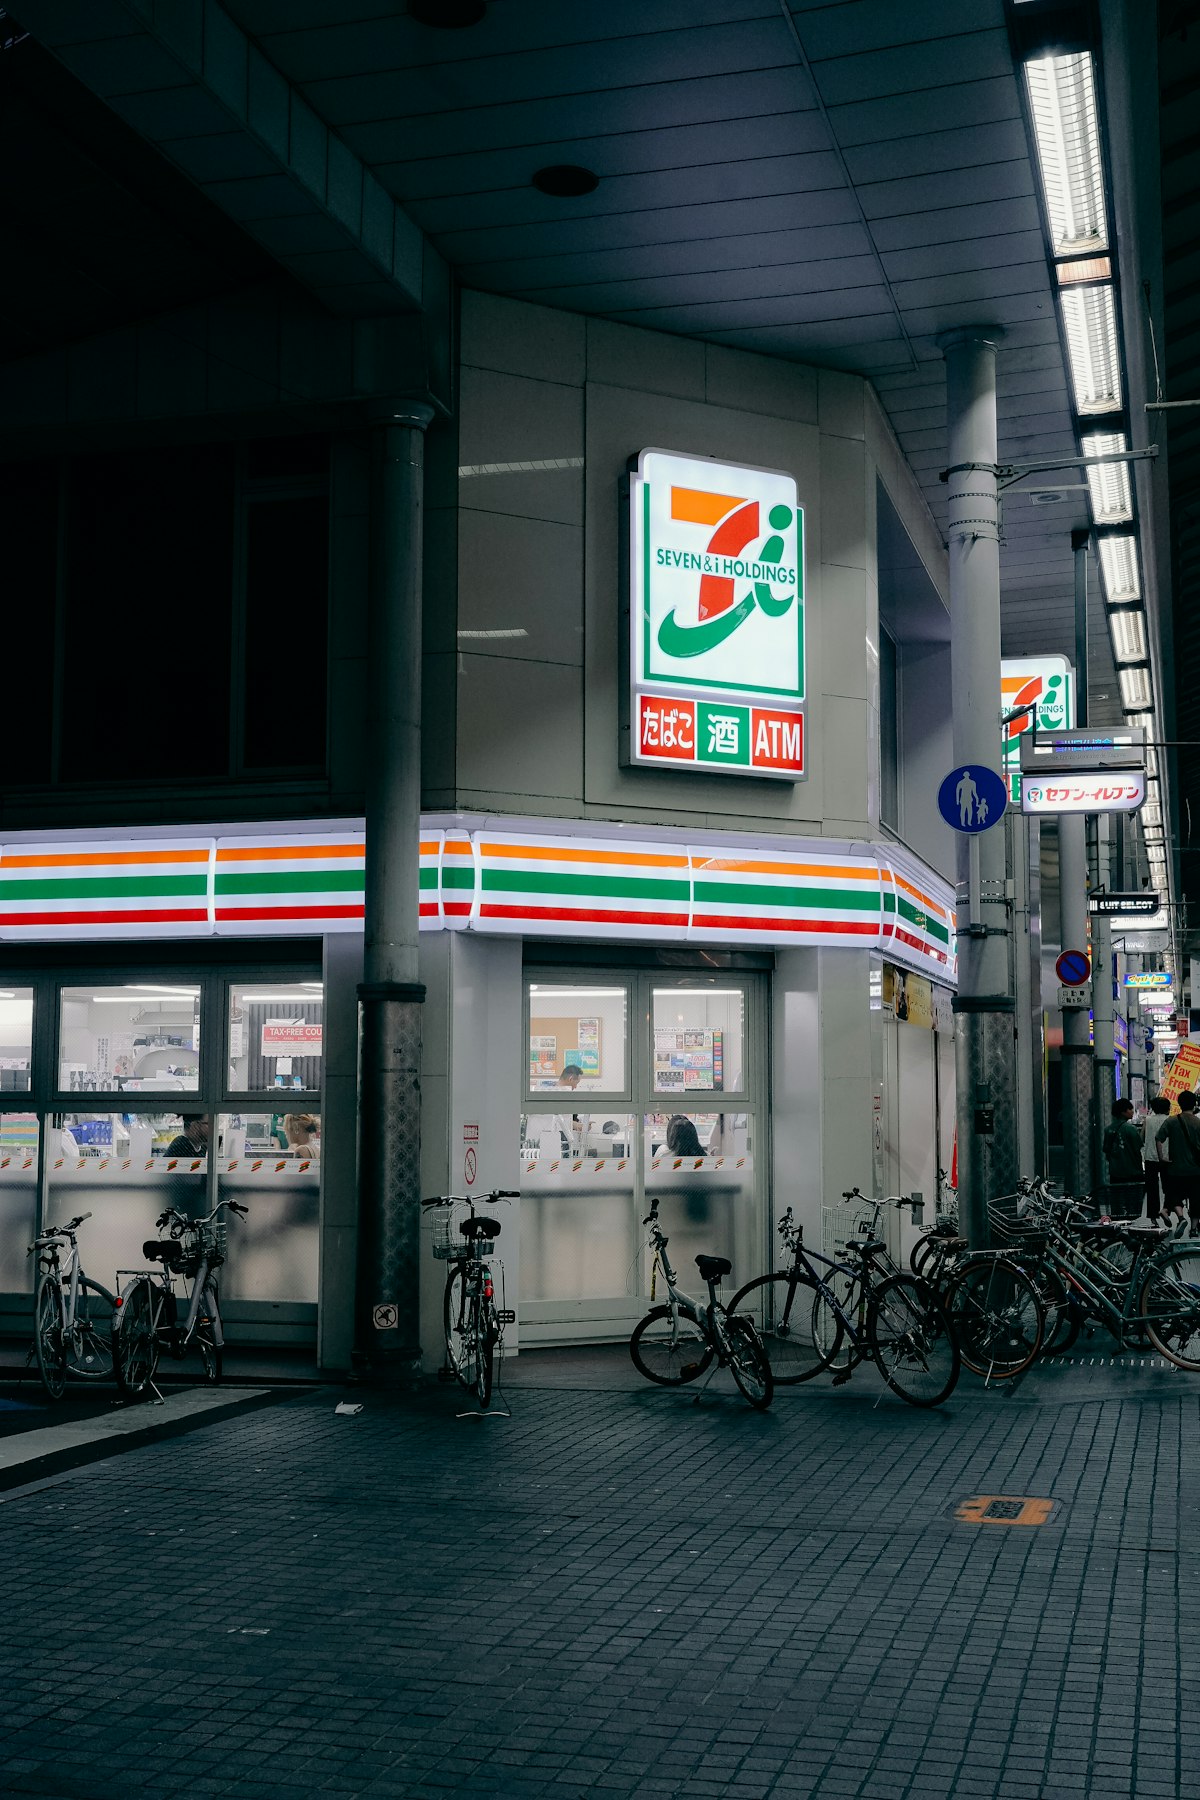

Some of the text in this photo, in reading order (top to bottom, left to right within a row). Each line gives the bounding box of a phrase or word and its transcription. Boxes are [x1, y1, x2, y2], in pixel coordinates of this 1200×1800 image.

[723, 559, 796, 585] HOLDINGS
[642, 707, 800, 761] たばこ 酒 ATM
[1100, 901, 1153, 910] SUIT SELECT
[1173, 1064, 1191, 1079] Tax
[1168, 1076, 1191, 1091] Free
